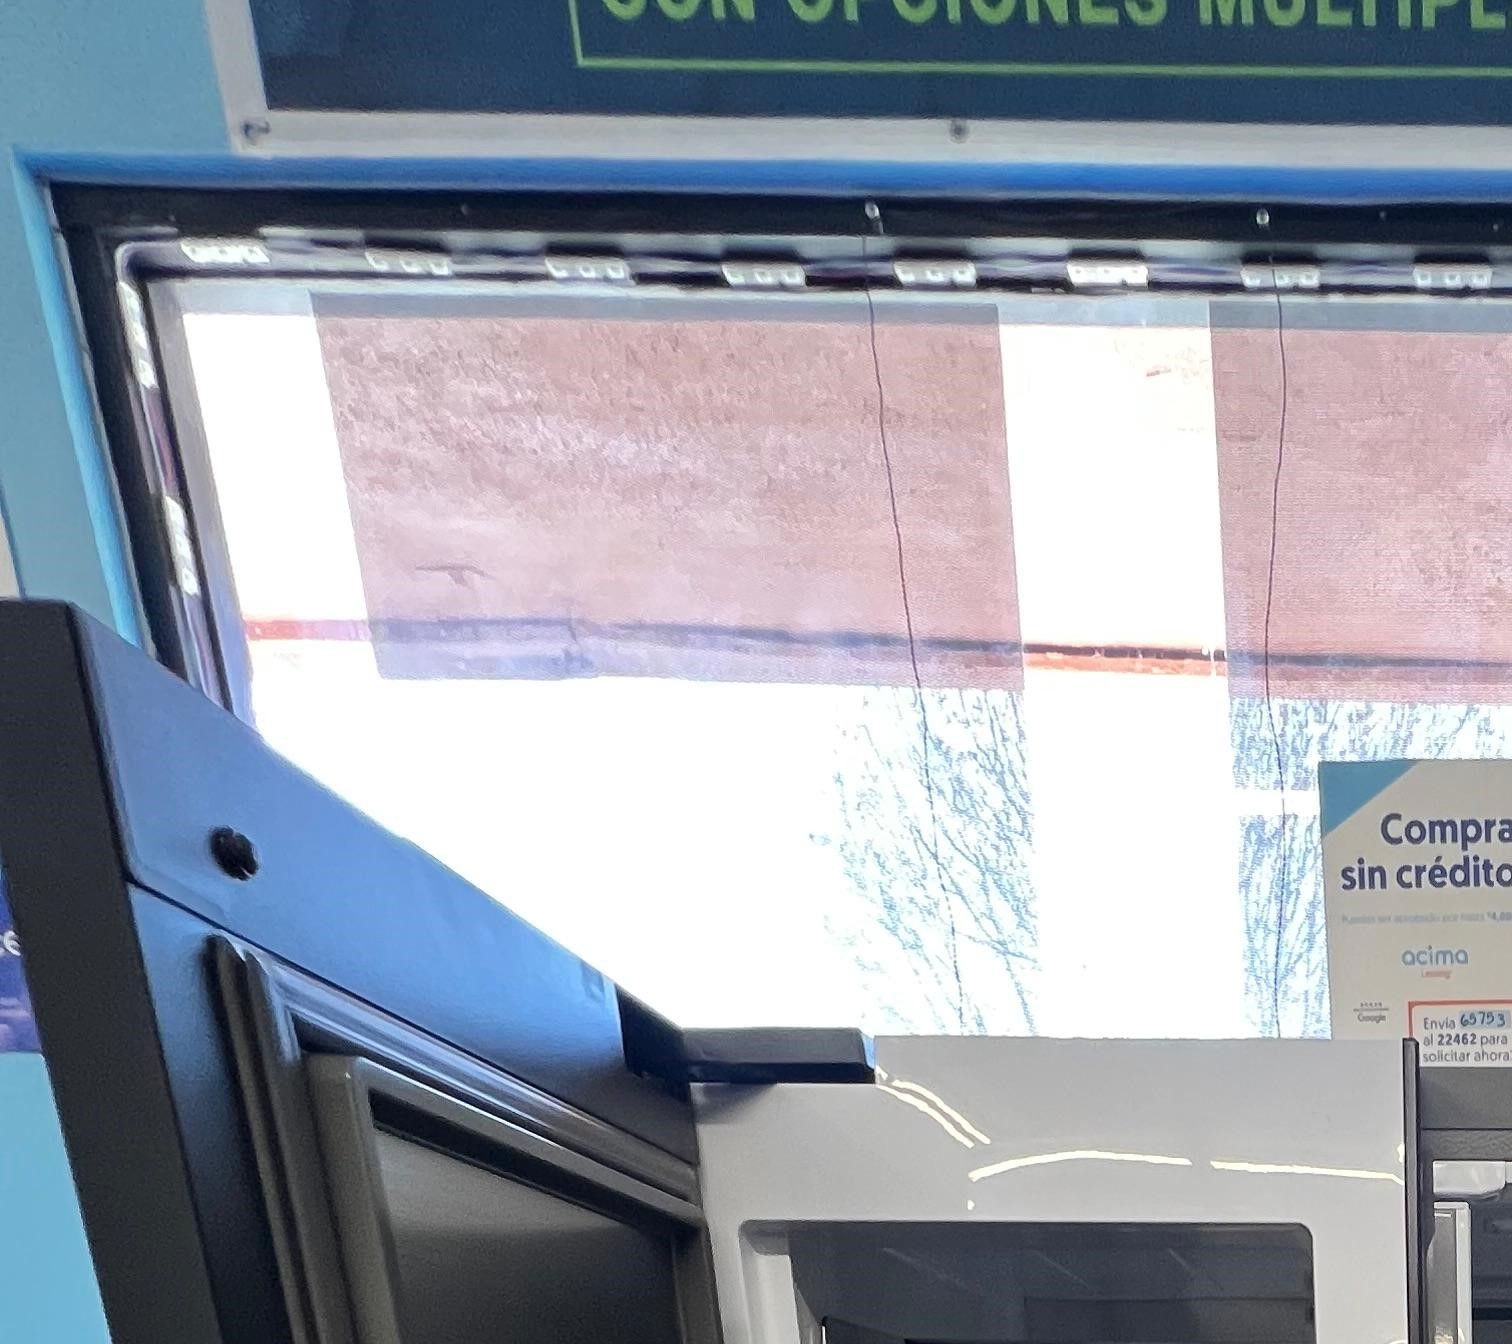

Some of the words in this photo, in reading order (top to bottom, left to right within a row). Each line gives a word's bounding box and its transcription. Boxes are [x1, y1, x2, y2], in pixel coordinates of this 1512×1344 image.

[1340, 856, 1388, 891] sin
[1401, 945, 1470, 966] acima
[1423, 1034, 1434, 1047] al
[1437, 1032, 1477, 1046] 22462
[1480, 1034, 1508, 1049] para
[1423, 1048, 1471, 1063] solicitar
